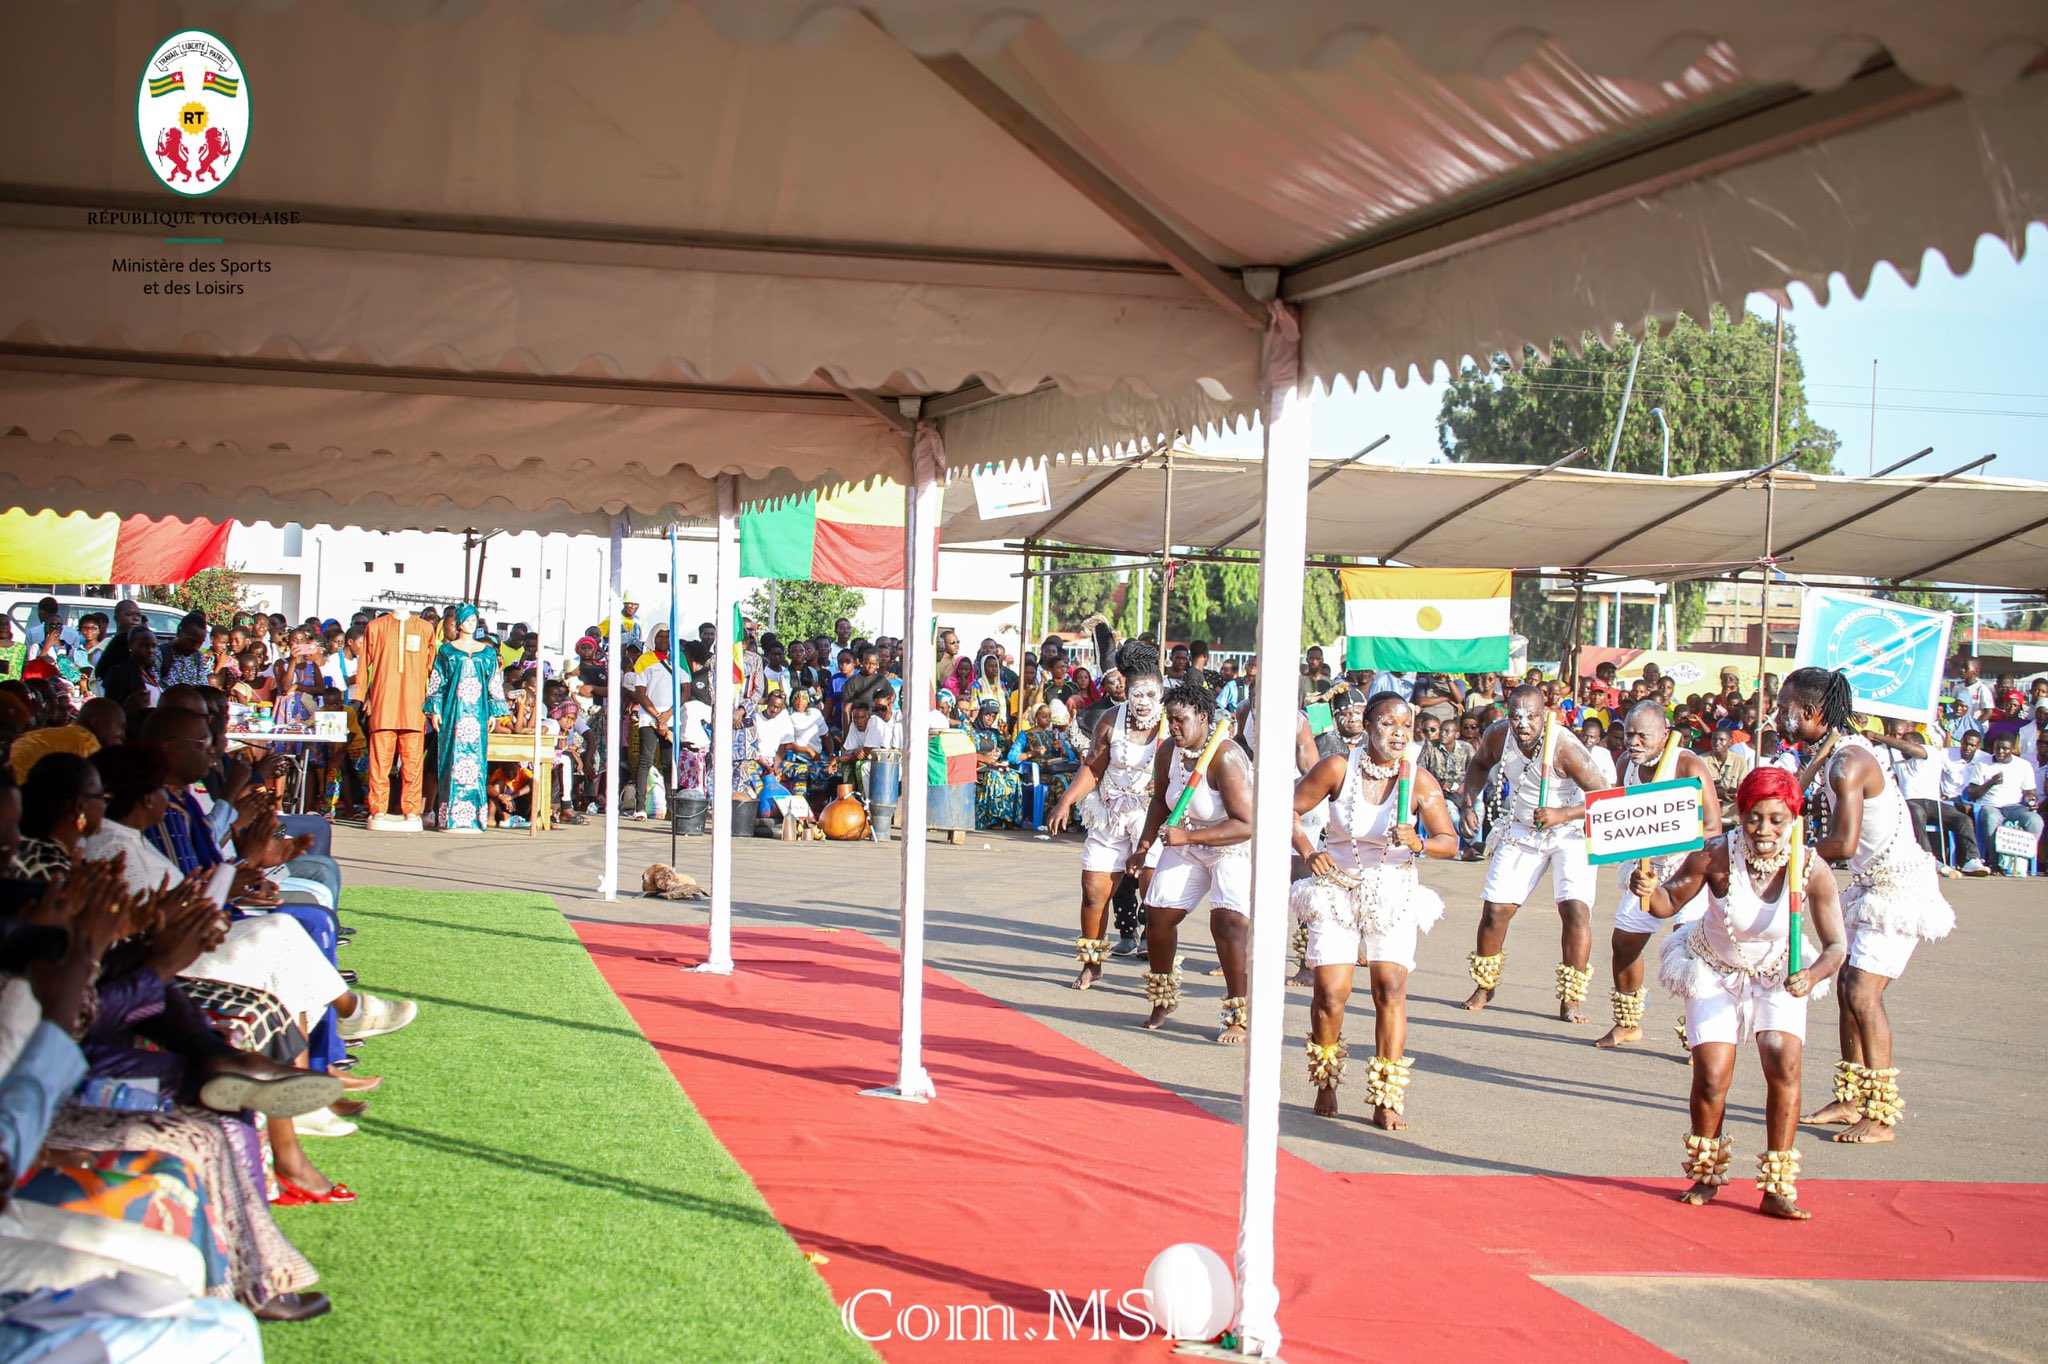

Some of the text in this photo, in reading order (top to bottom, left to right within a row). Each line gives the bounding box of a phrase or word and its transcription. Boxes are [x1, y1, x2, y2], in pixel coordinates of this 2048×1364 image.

[1592, 799, 1696, 824] REGION DES
[1604, 819, 1680, 841] SAVANES
